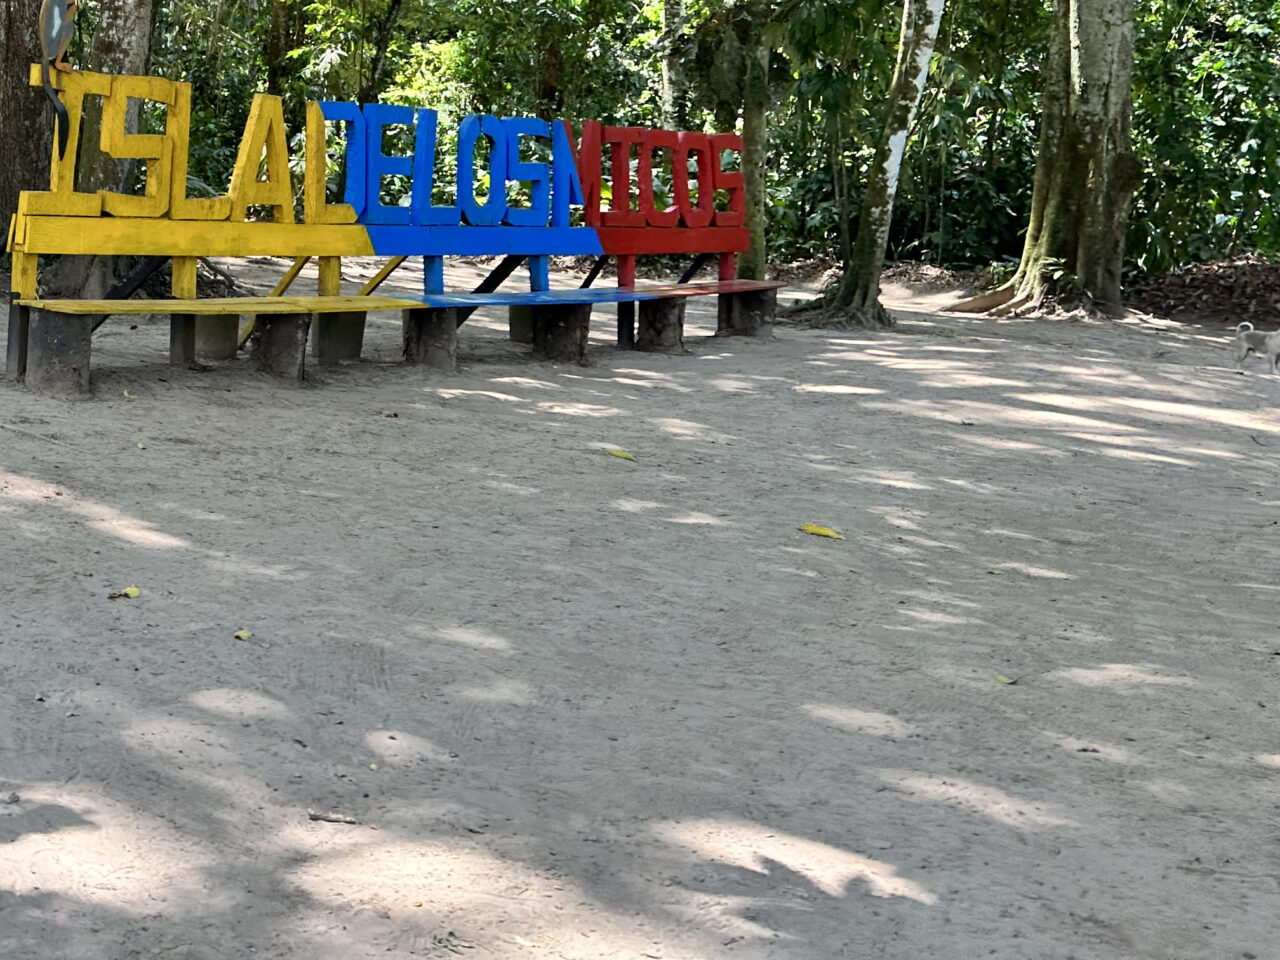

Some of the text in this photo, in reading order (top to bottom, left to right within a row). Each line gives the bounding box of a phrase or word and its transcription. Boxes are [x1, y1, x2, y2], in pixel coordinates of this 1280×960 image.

[19, 63, 746, 228] ISLA DE LOS MICOS
